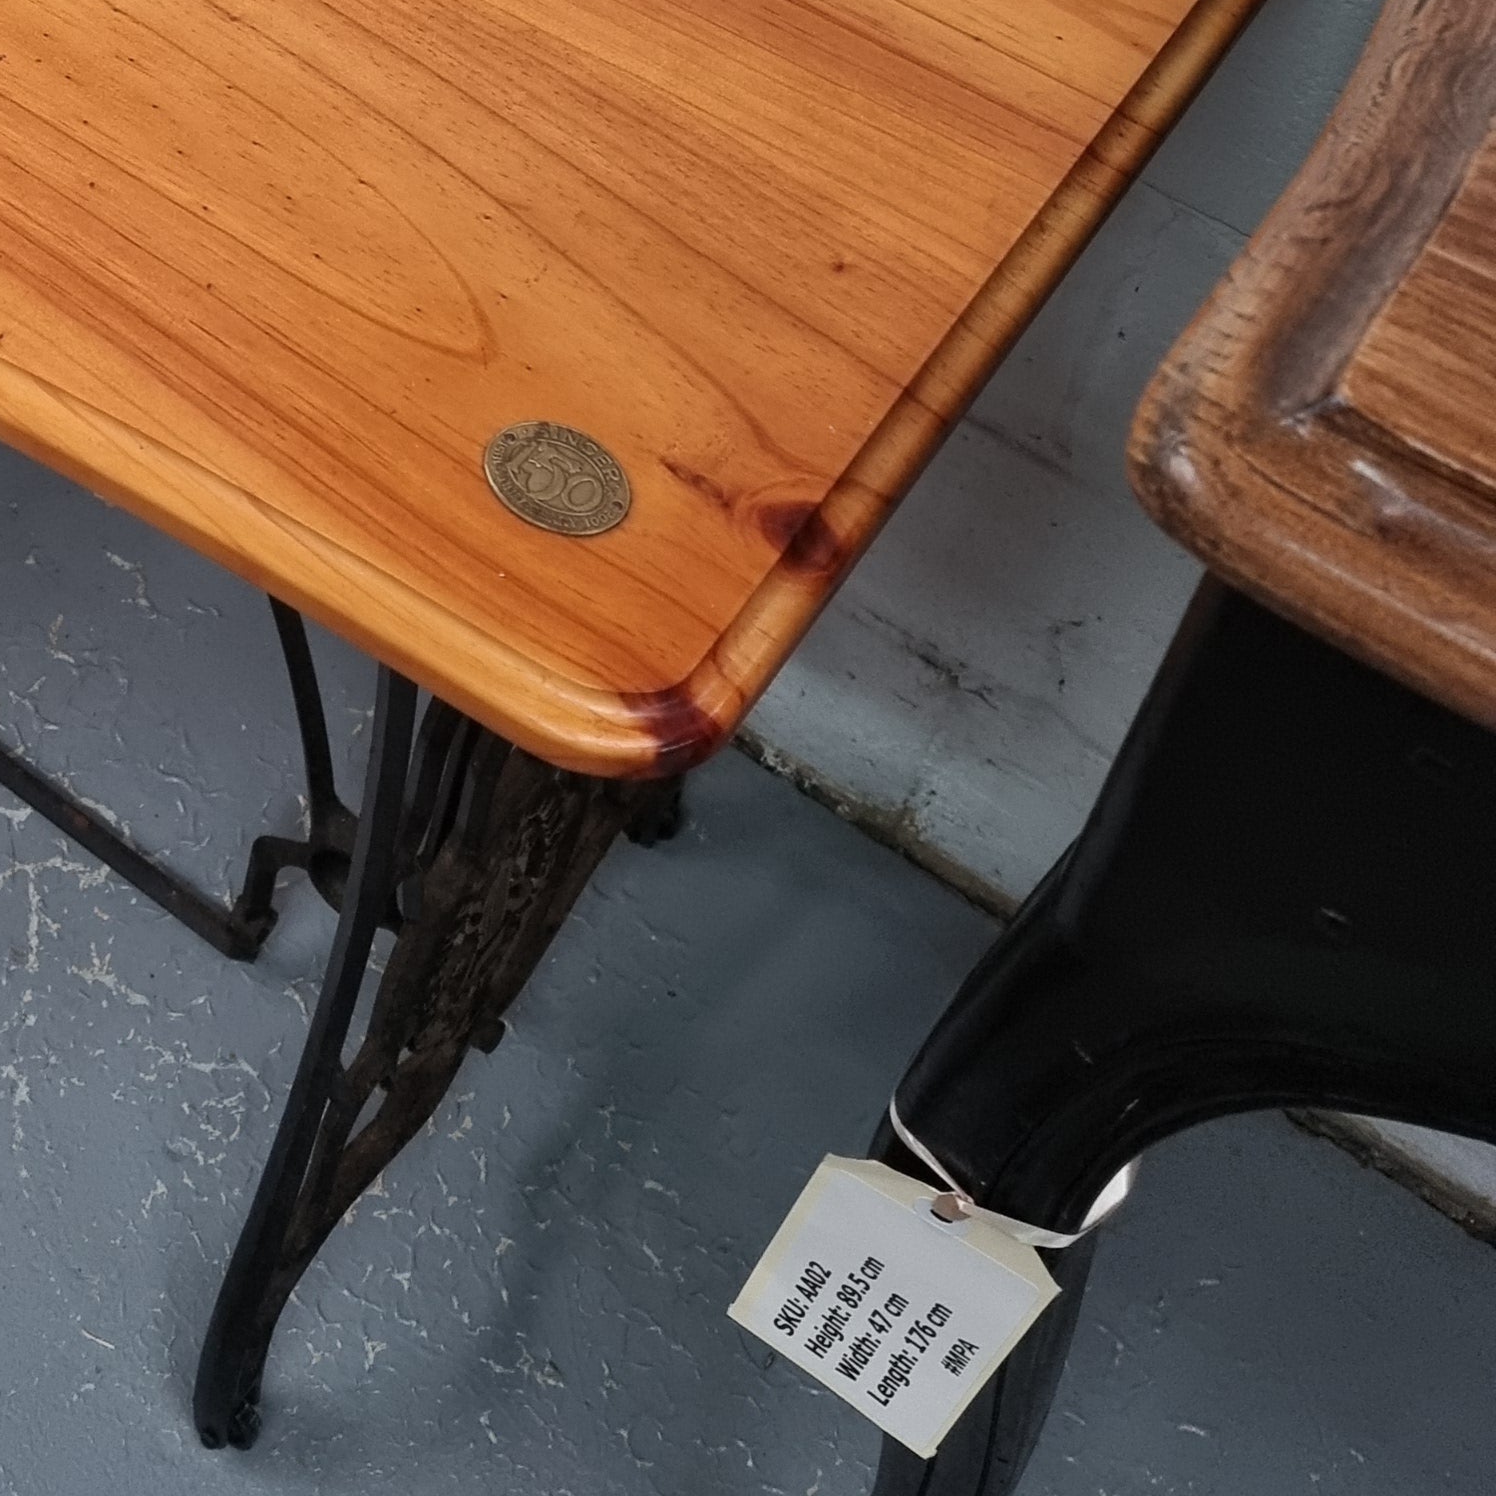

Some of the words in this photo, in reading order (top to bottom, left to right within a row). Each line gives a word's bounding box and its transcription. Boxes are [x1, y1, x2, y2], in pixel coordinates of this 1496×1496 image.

[535, 426, 621, 482] SINGER
[773, 1297, 809, 1336] SKU:
[795, 1260, 832, 1303] AA02
[804, 1305, 852, 1359] Height:
[836, 1272, 871, 1309] 89.5
[860, 1256, 885, 1280] cm
[835, 1332, 881, 1381] Width:
[867, 1309, 893, 1334] 47
[884, 1293, 910, 1317] cm
[866, 1349, 919, 1407] Length:
[904, 1320, 937, 1354] 176
[926, 1302, 953, 1327] cm
[940, 1338, 980, 1377] #MPA
